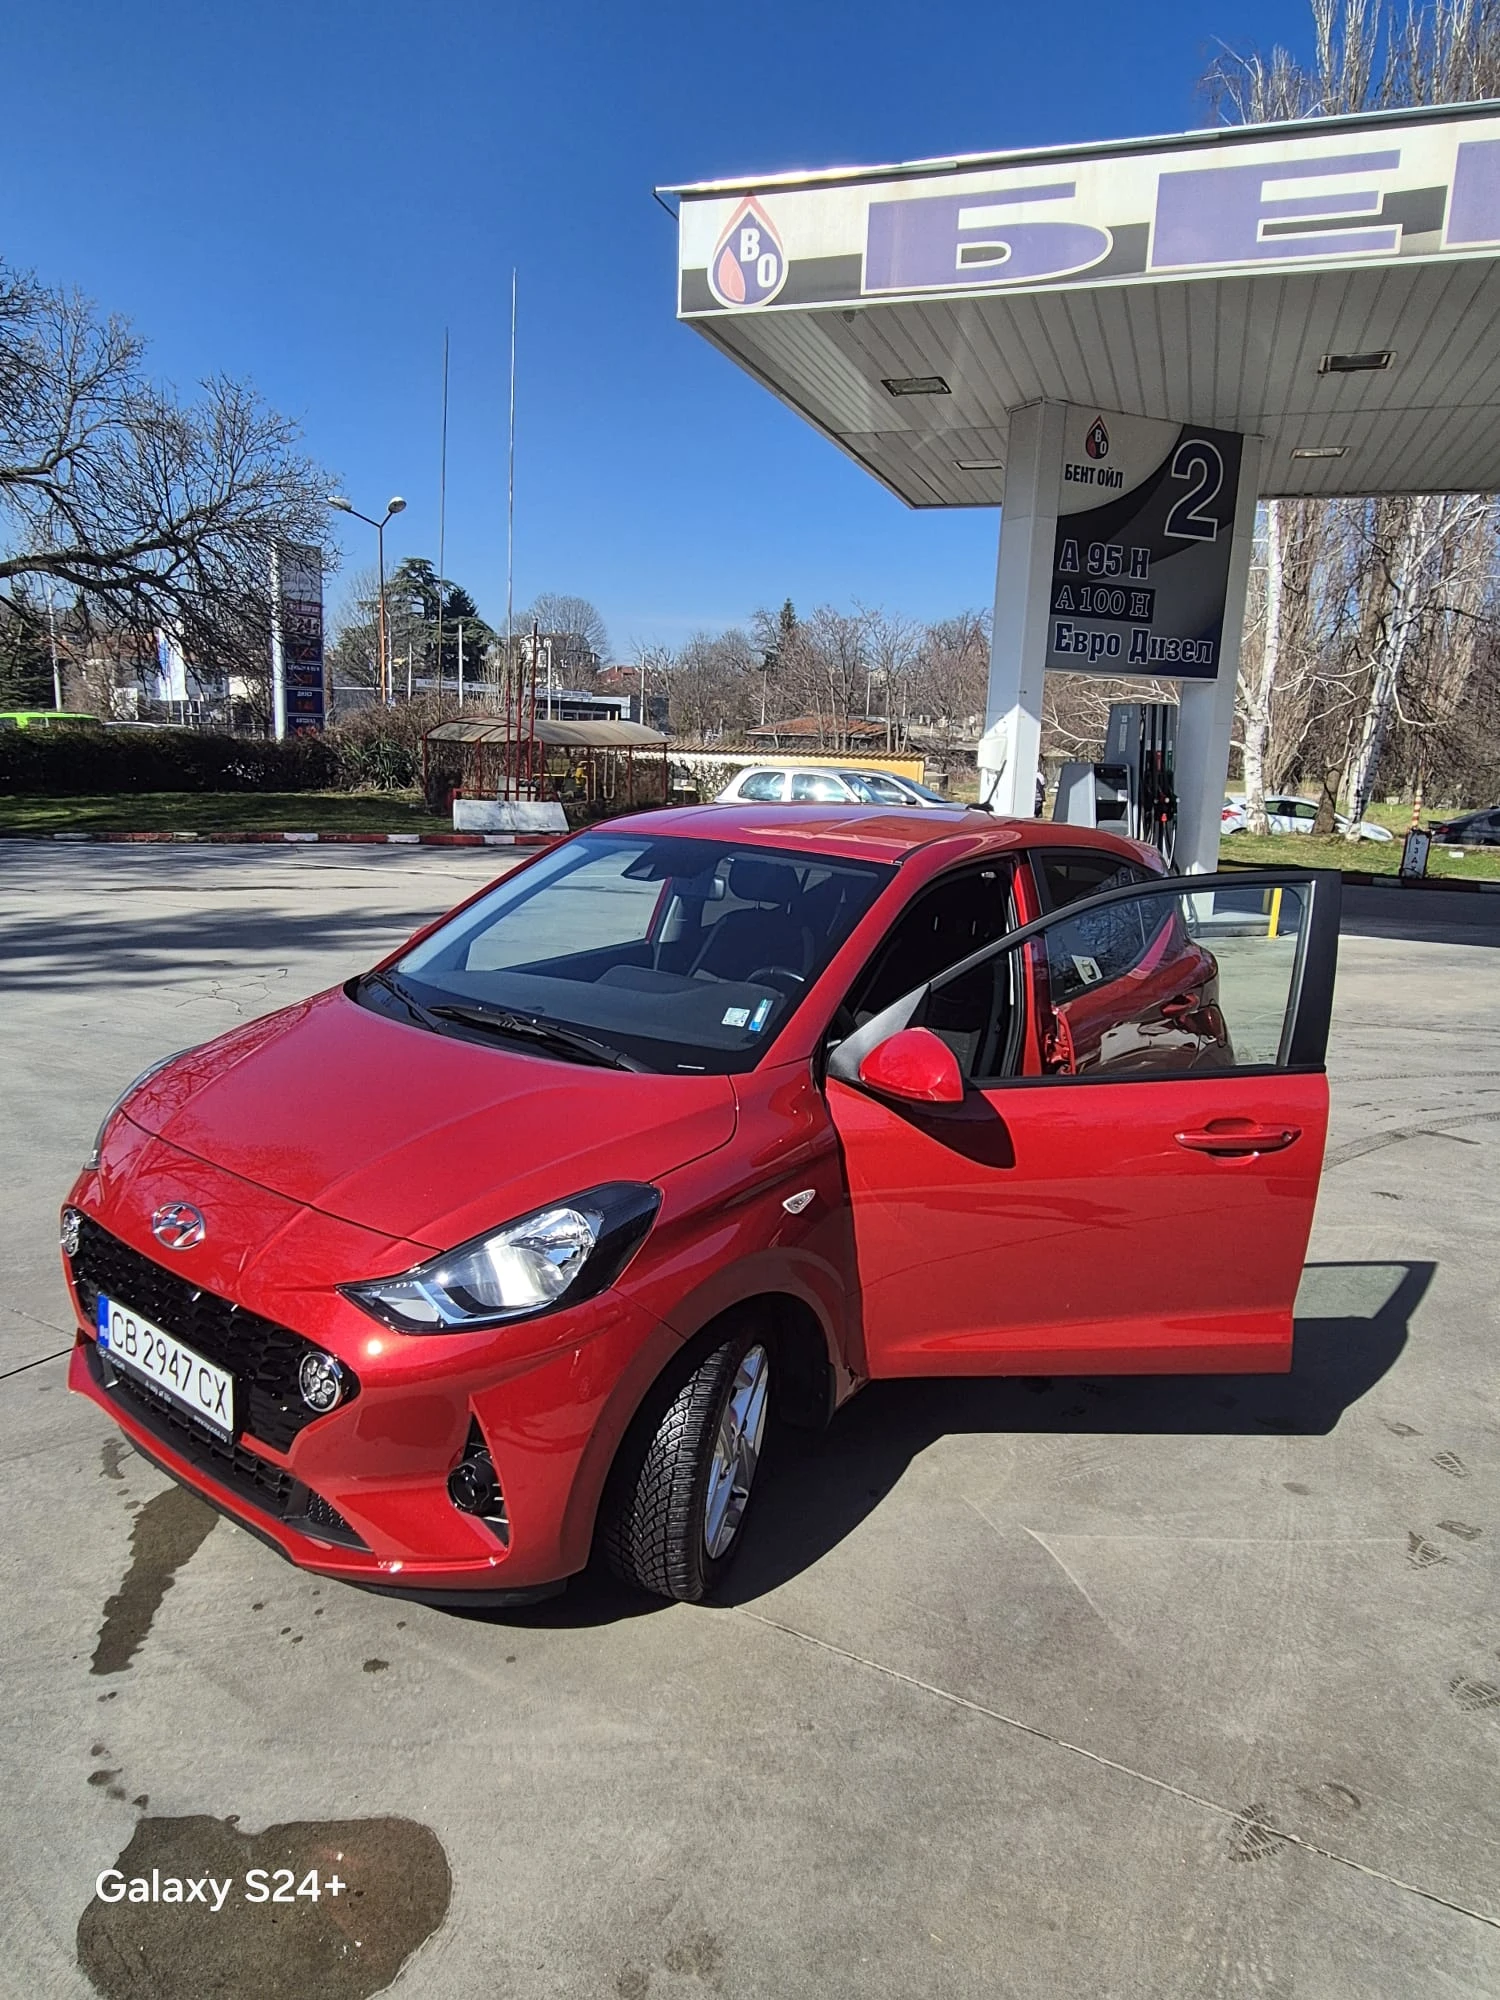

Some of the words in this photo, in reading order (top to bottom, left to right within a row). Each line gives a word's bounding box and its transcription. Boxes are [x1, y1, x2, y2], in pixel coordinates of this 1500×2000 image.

[861, 138, 1500, 295] БЕ
[1064, 463, 1097, 485] БЕНТ
[1097, 466, 1124, 489] ОЙЛ
[1164, 438, 1224, 542] 2
[1087, 543, 1123, 577] 95
[1080, 587, 1126, 615] 100
[1054, 622, 1122, 663] Евро
[1128, 628, 1214, 664] Дизел
[112, 1311, 138, 1358] CB
[143, 1330, 193, 1391] 2947
[198, 1367, 227, 1421] CX
